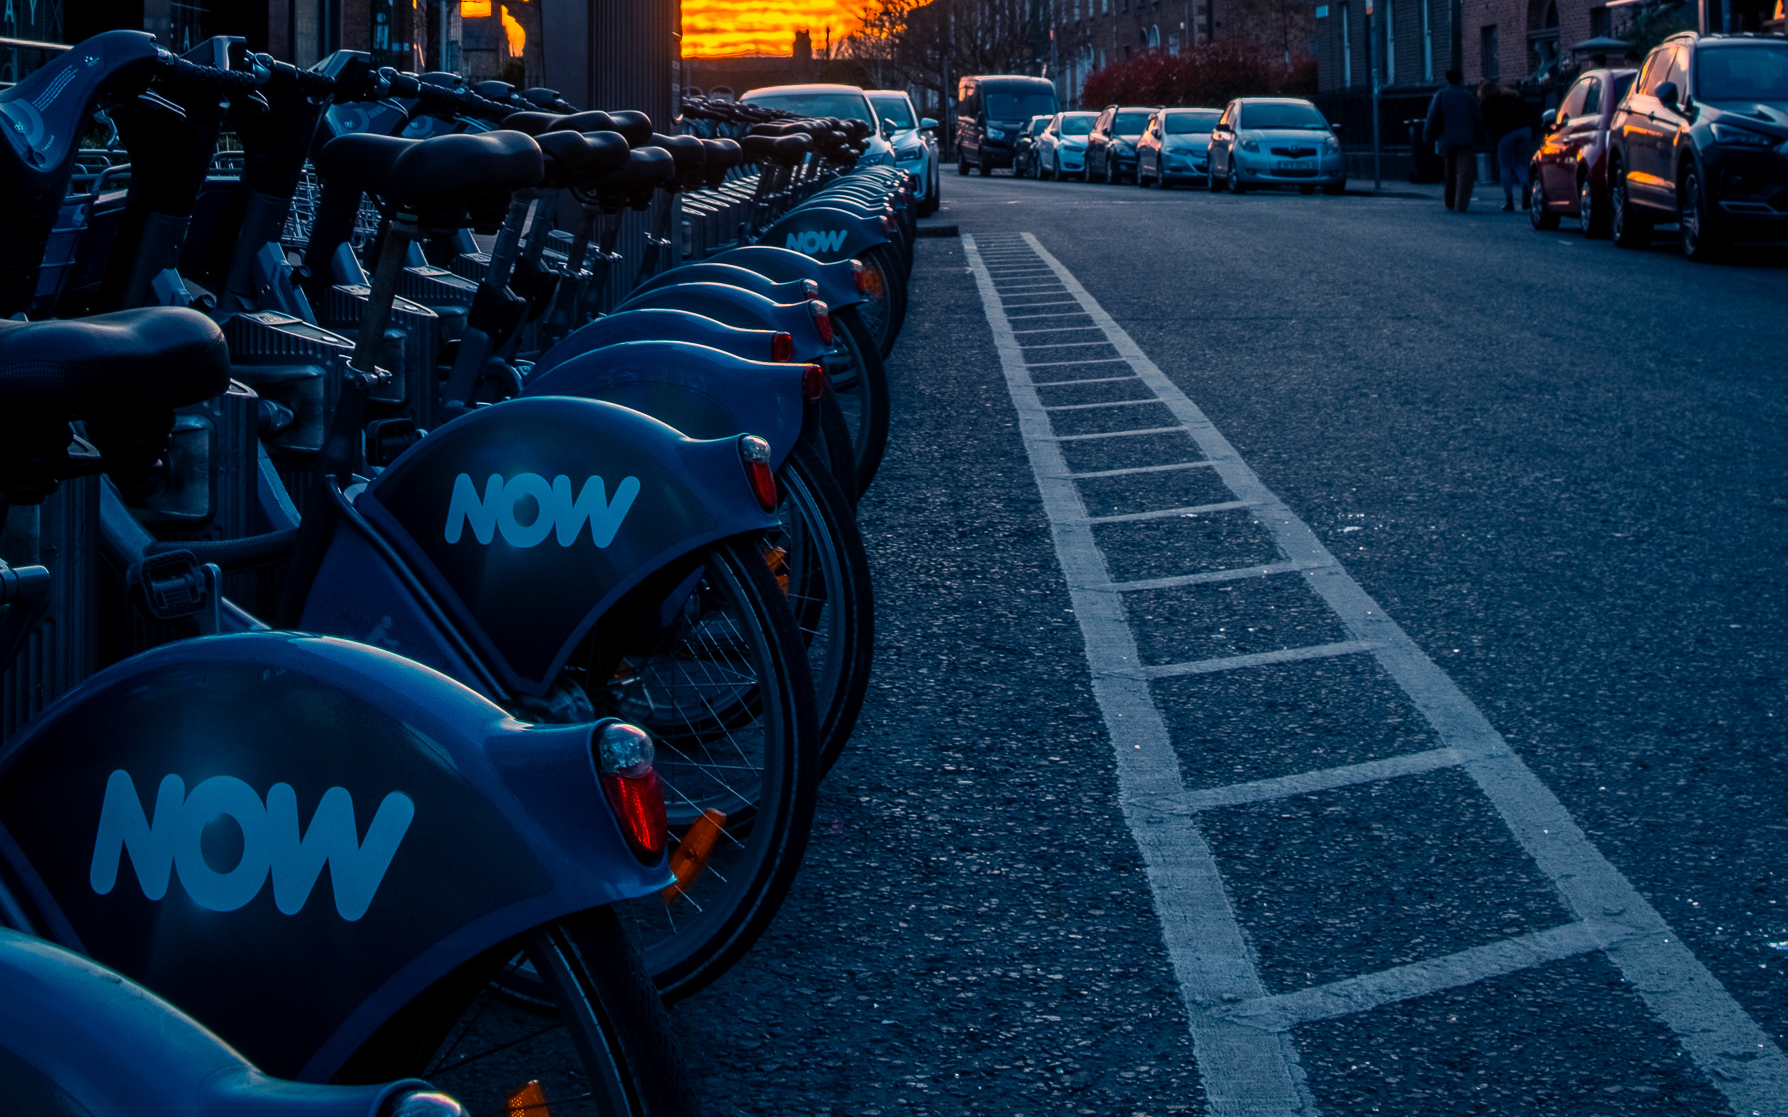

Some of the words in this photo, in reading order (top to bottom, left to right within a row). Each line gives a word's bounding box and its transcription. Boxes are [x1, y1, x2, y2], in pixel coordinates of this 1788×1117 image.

[786, 229, 848, 255] NOW
[445, 472, 640, 549] NOW
[90, 769, 415, 922] NOW
